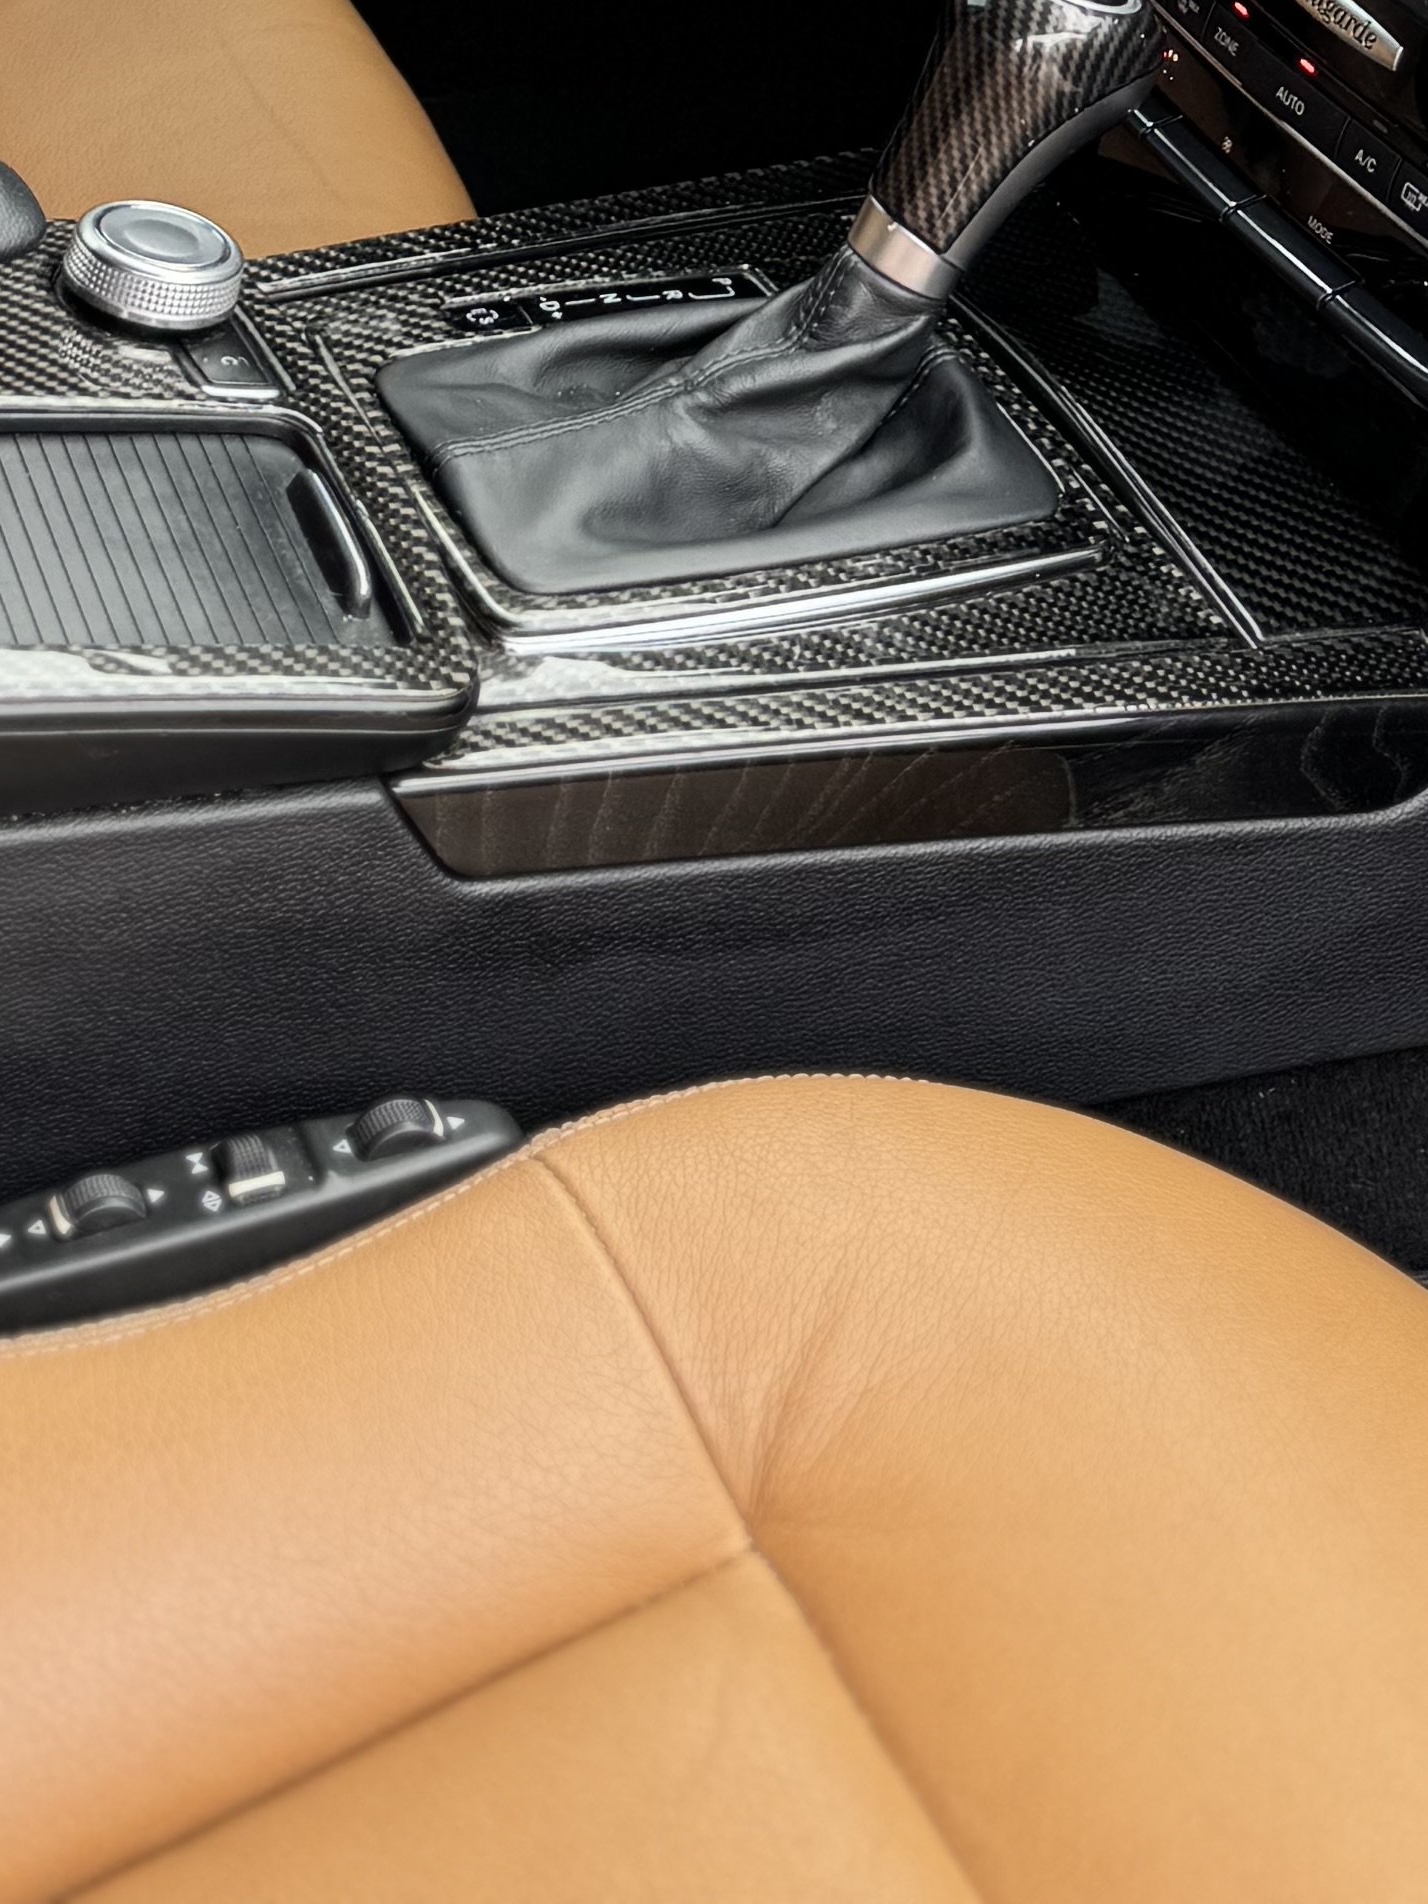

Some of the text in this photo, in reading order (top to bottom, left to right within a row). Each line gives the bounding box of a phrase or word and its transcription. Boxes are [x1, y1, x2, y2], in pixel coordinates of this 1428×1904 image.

[1213, 26, 1240, 57] ZONE
[1275, 85, 1305, 116] AUTO
[1354, 148, 1378, 173] A/C
[1307, 215, 1334, 245] MODE
